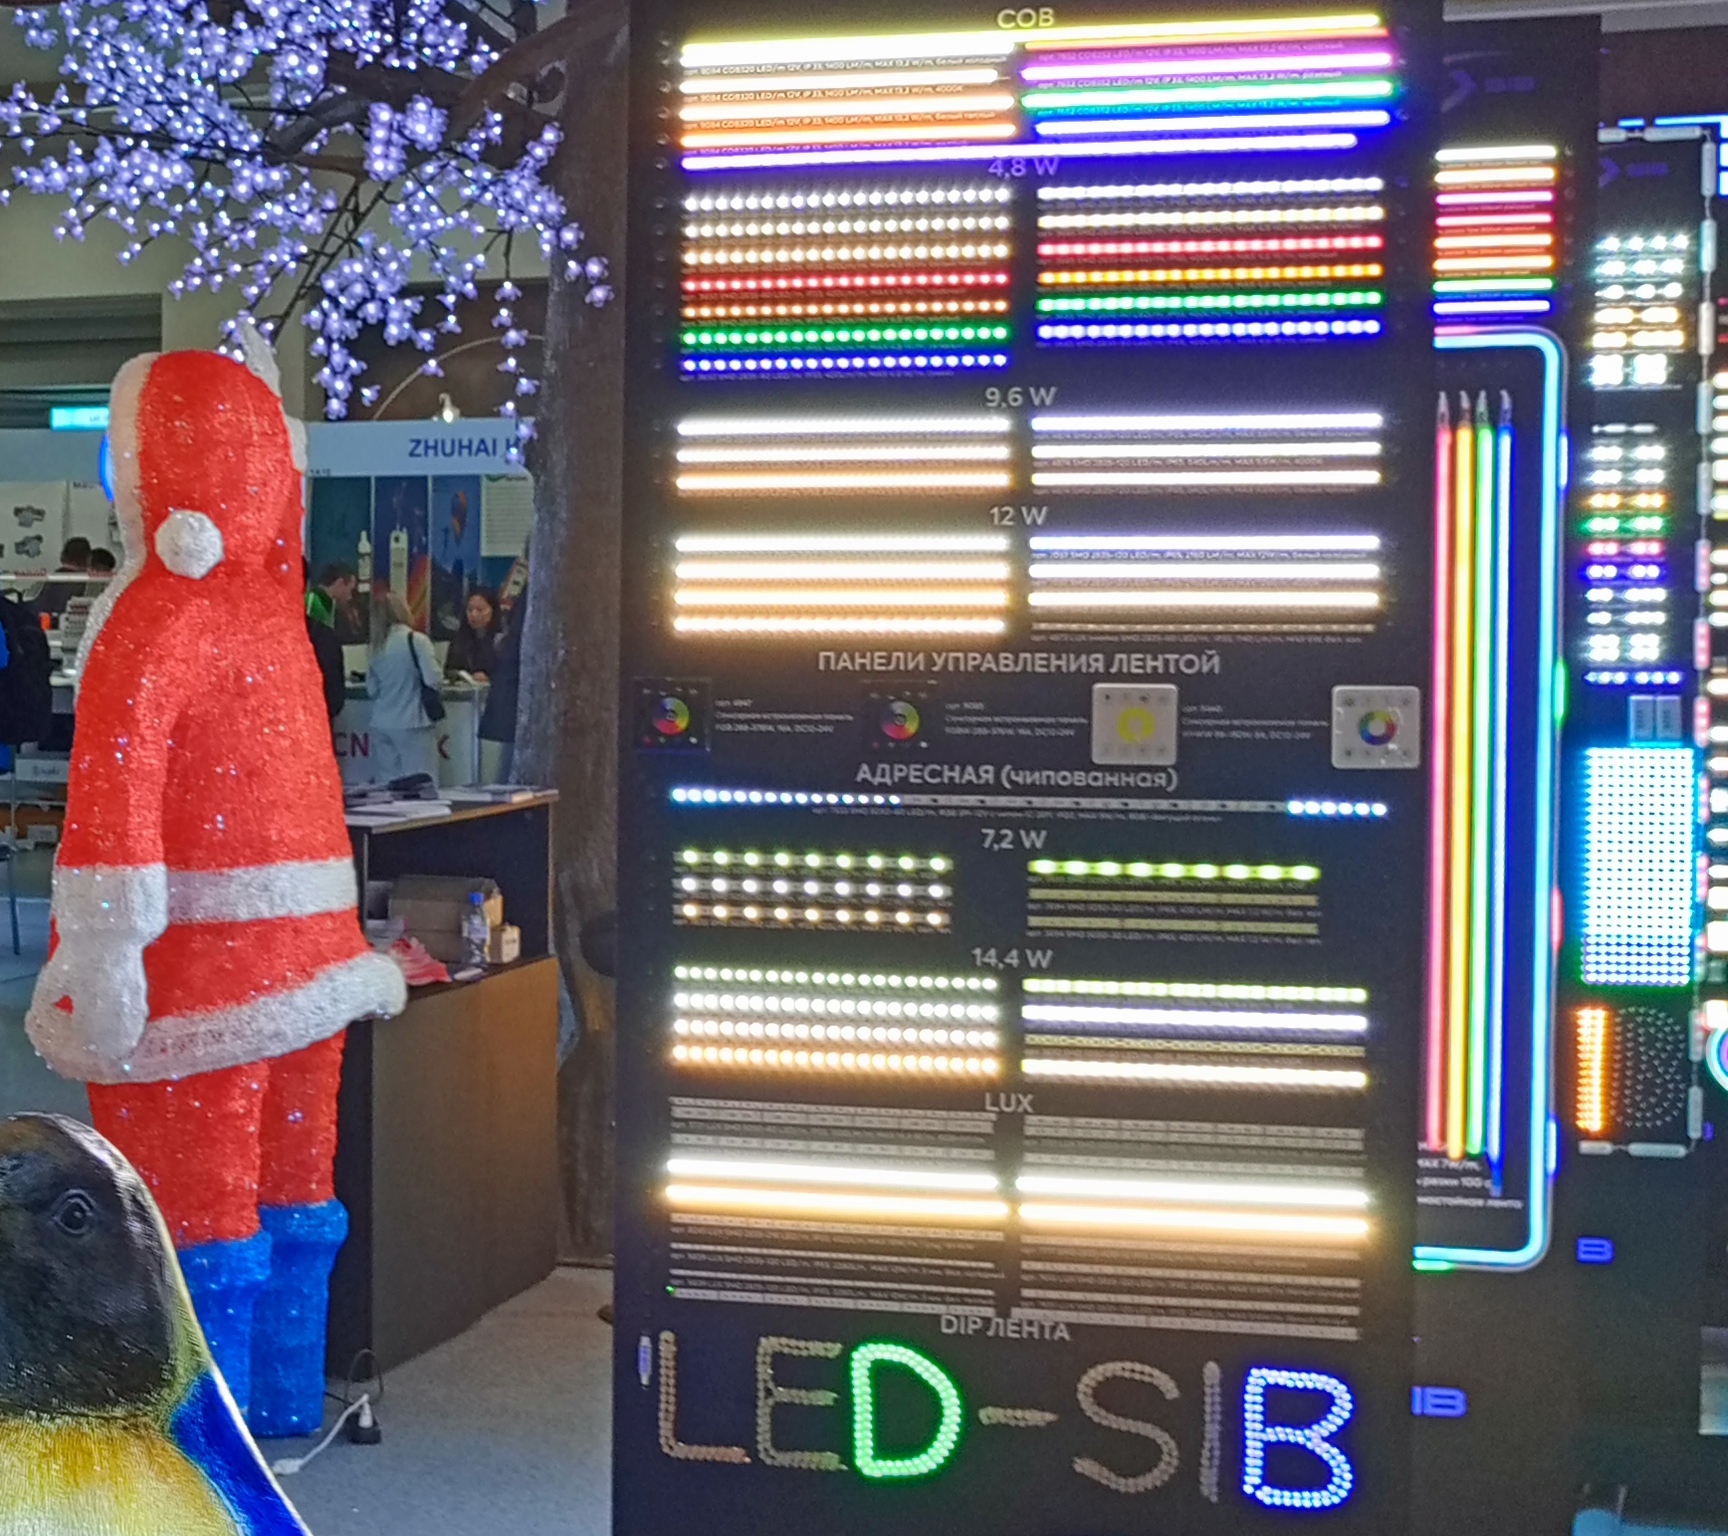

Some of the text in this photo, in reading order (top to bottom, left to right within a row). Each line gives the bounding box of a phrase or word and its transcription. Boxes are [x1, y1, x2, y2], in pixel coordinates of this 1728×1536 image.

[997, 8, 1056, 30] COB
[1027, 157, 1060, 177] W
[1028, 386, 1057, 407] W
[408, 437, 497, 458] ZHUHAI
[989, 506, 1048, 526] 12 W
[818, 650, 1221, 675] ПАНЕЛИ УПРАВЛЕНИЯ ЛЕНТОЙ
[855, 764, 1179, 792] АДРЕСНАЯ (чипованная)
[980, 827, 1048, 851] 7,2 W
[972, 948, 1054, 969] 14,4 W
[984, 1092, 1035, 1114] LUX
[940, 1315, 1071, 1341] DIP ЛЕНТА
[1410, 1385, 1468, 1418] IB
[659, 1330, 1355, 1510] LED-SIB
